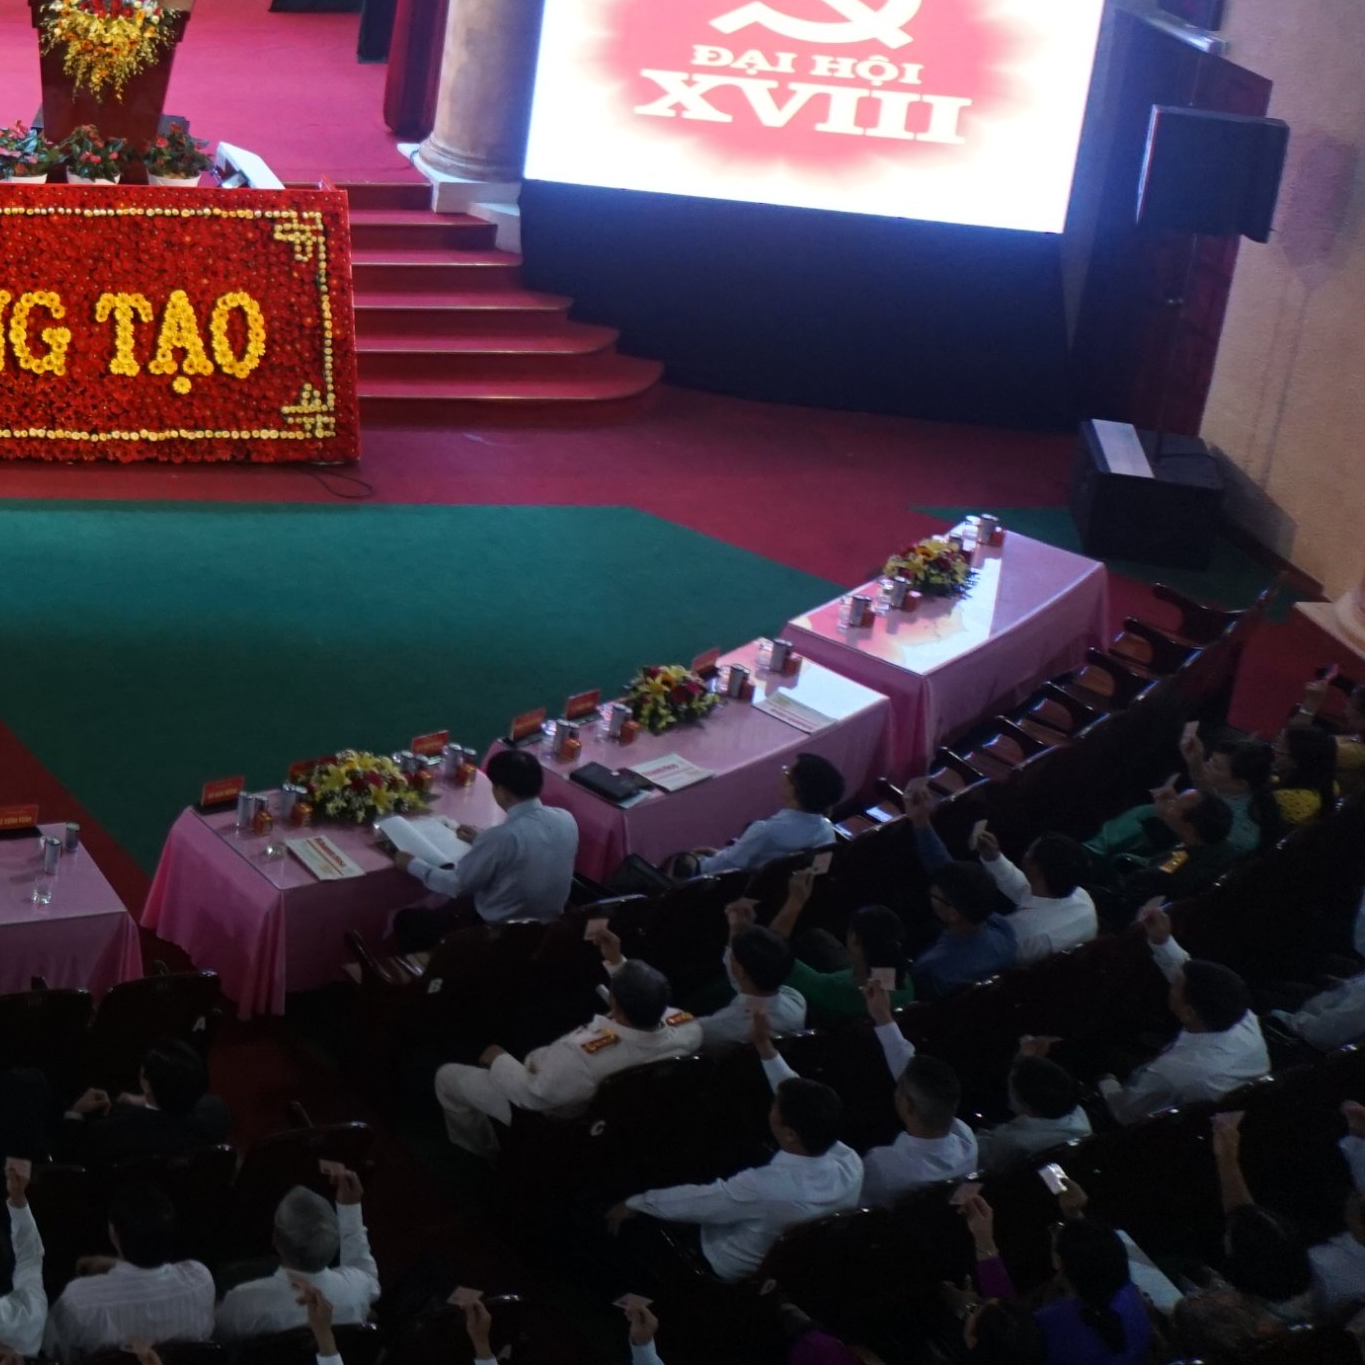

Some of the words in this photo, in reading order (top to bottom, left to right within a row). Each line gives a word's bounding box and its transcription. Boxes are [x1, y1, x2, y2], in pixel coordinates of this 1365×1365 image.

[691, 44, 797, 75] ĐẠI
[810, 54, 925, 86] HỘI
[634, 68, 972, 144] XVIII
[95, 289, 266, 395] TẠO
